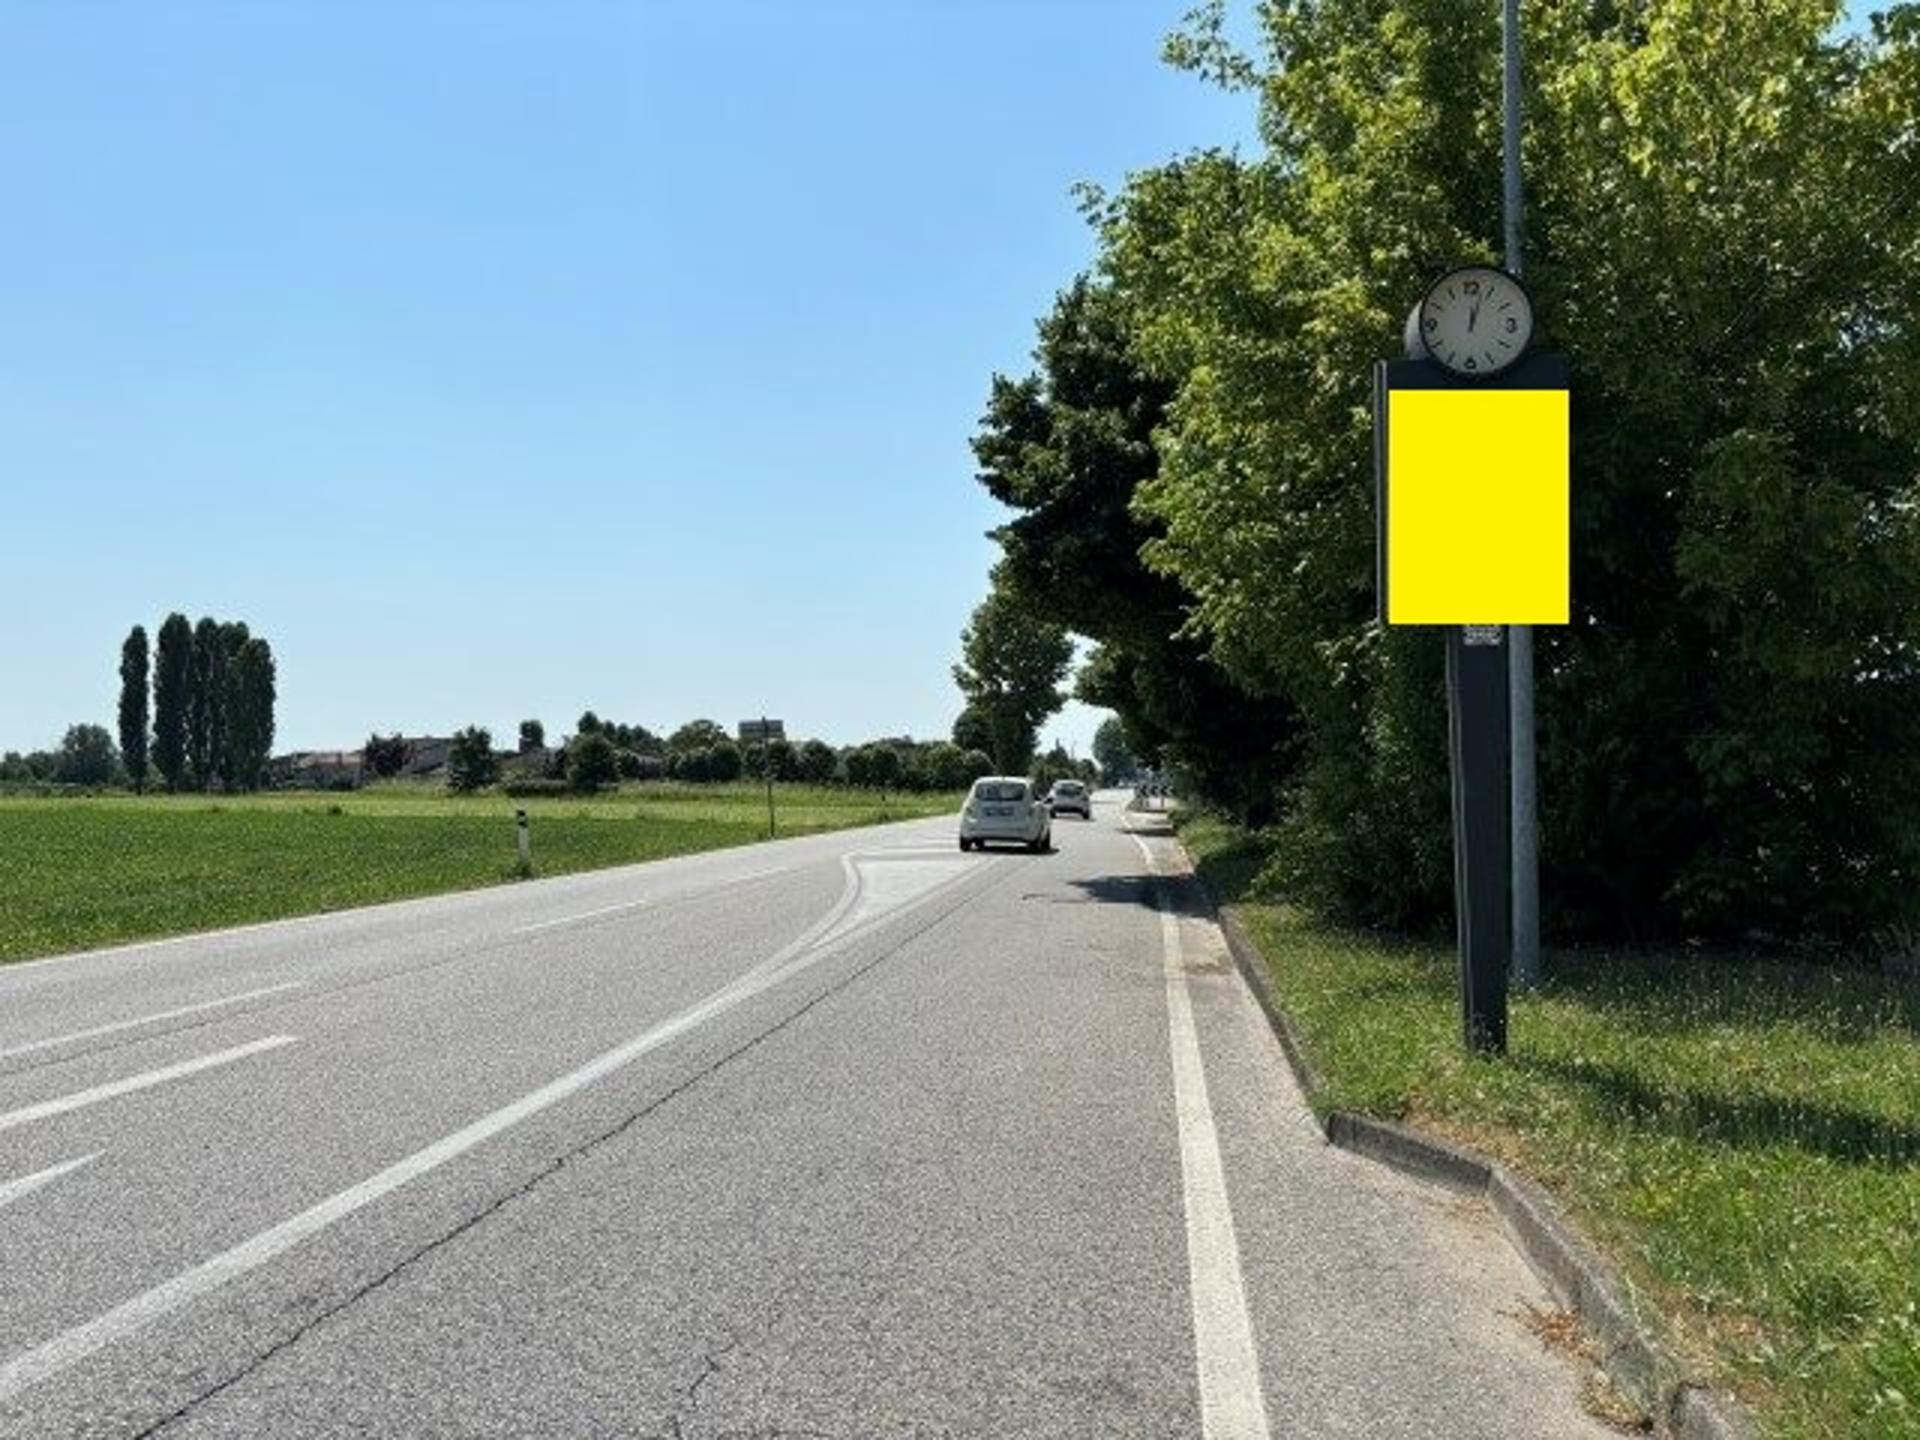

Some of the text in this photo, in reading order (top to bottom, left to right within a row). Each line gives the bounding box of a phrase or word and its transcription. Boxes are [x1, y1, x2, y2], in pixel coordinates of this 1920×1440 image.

[1463, 281, 1480, 295] 12
[1425, 318, 1438, 333] 9
[1505, 317, 1517, 333] 3
[1464, 356, 1477, 369] 6
